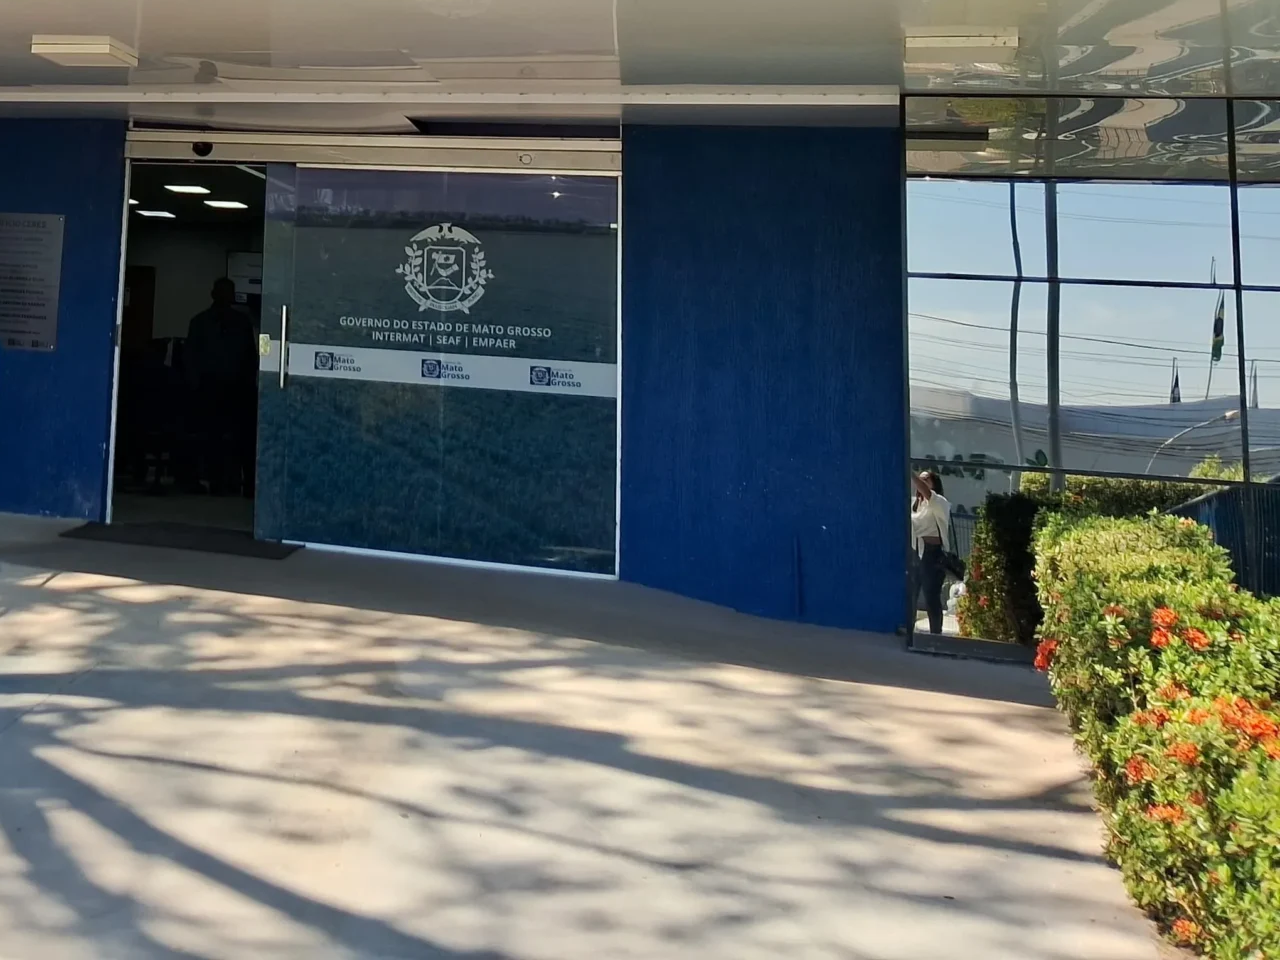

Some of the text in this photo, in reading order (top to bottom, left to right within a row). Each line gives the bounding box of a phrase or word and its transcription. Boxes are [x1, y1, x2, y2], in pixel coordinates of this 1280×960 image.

[339, 316, 552, 338] GOVERNO DO ESTADO DE MATO GROSSO
[372, 331, 516, 349] INTERMAT SEAF EMPAER
[334, 356, 355, 365] Mato
[333, 363, 362, 373] Grosso
[441, 364, 463, 373] Mato
[441, 371, 470, 381] Grosso
[551, 371, 574, 380] Mato
[551, 379, 582, 389] Grosso
